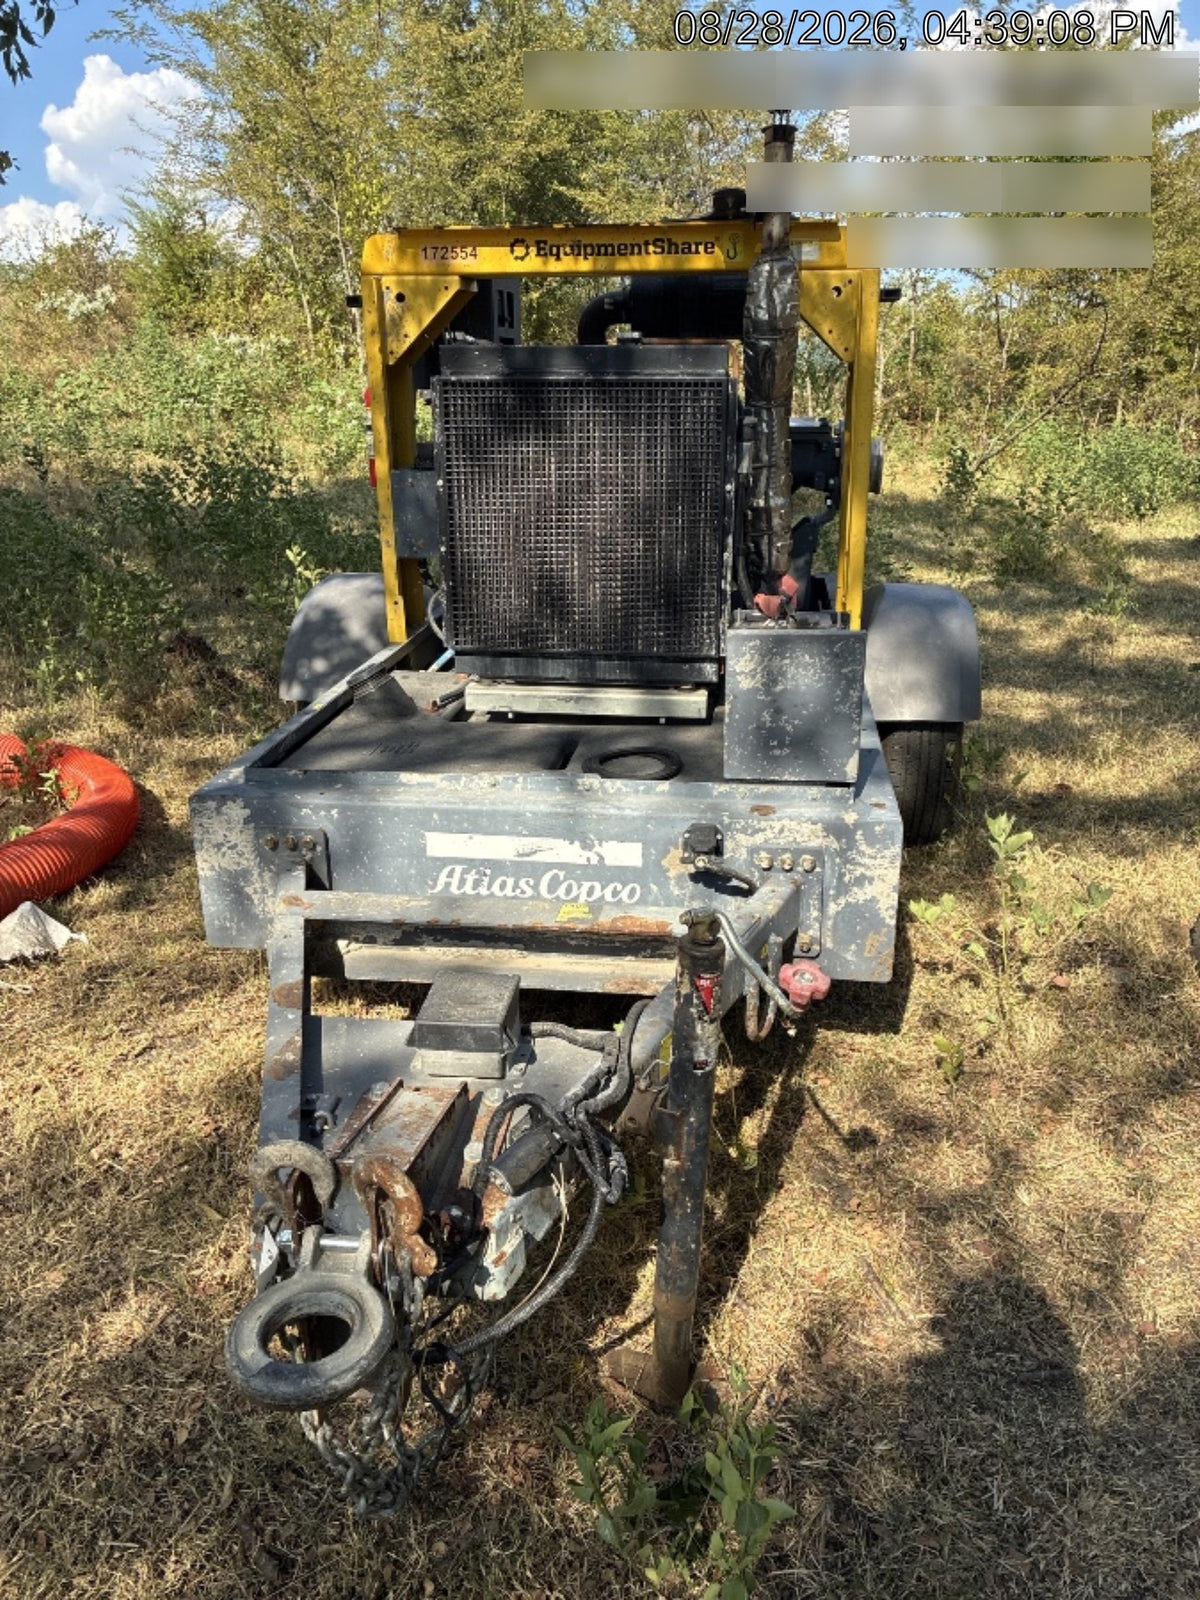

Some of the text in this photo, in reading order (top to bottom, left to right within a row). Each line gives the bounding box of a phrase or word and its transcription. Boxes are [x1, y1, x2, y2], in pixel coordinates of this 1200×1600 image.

[421, 246, 478, 260] 172554
[534, 237, 715, 261] EquipmentShare
[538, 870, 641, 904] Copco
